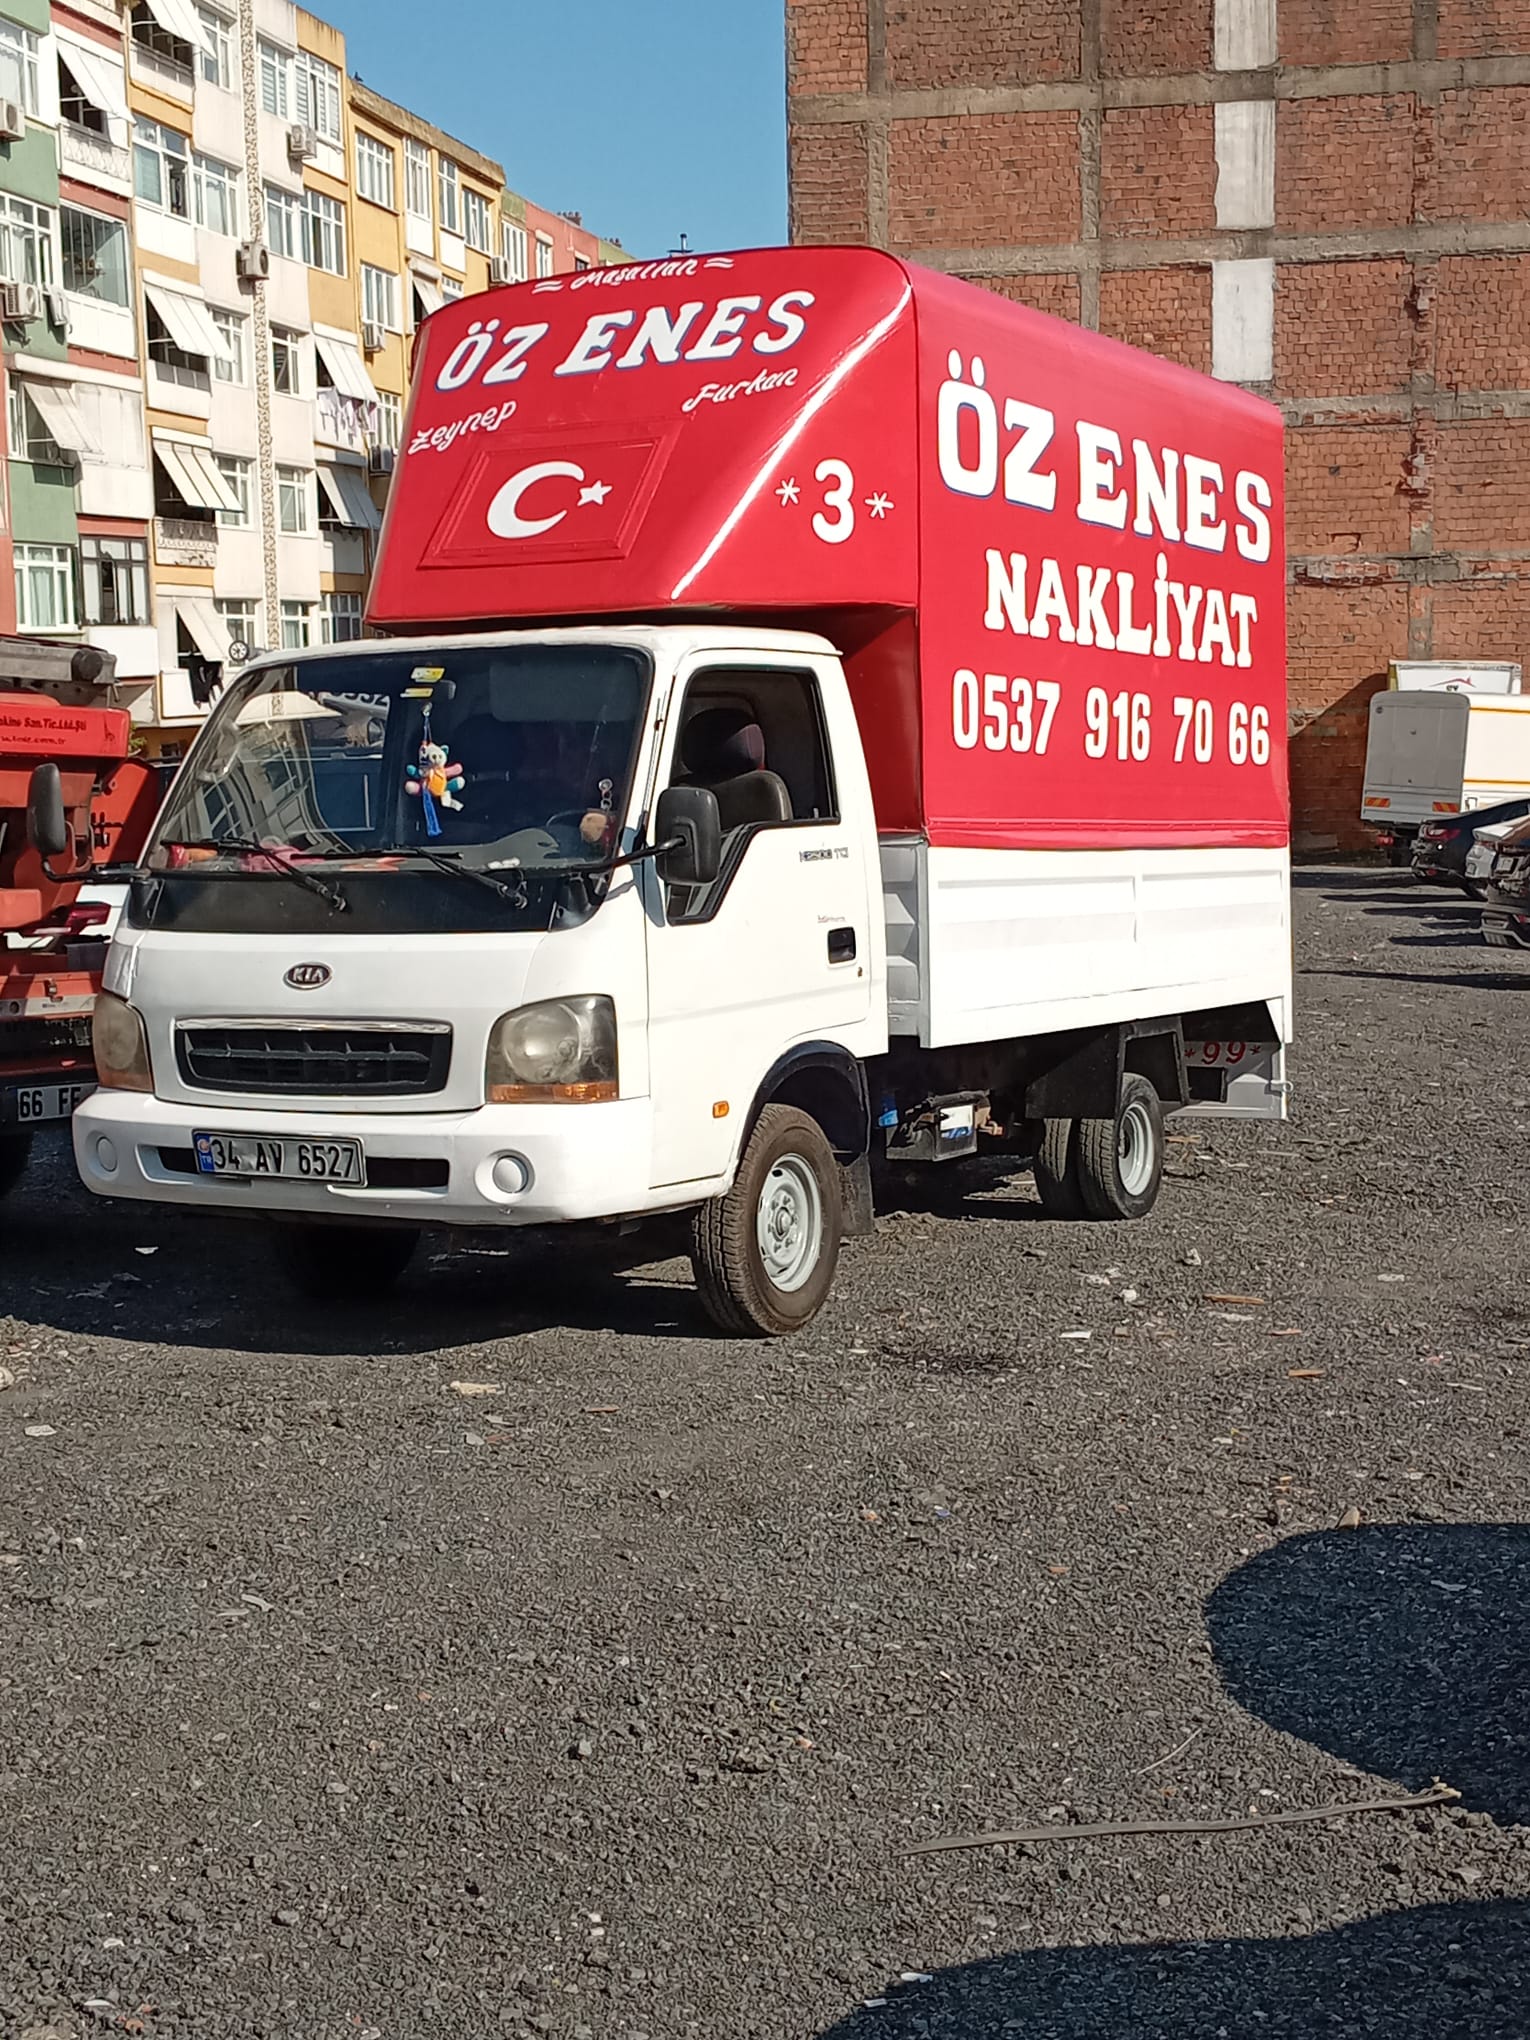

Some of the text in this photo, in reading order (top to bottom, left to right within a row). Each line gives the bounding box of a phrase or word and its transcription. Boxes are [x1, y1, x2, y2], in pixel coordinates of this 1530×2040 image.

[435, 290, 815, 392] ÖZ ENES
[681, 367, 799, 413] Furkan
[937, 348, 1272, 563] ÖZ ENES
[984, 548, 1258, 668] NAKLİYAT
[952, 668, 1270, 766] 0537 916 70 66
[292, 967, 324, 981] KIA
[1201, 1040, 1247, 1065] 99
[20, 1089, 43, 1118] 66
[211, 1138, 354, 1177] 34 AV 6527
